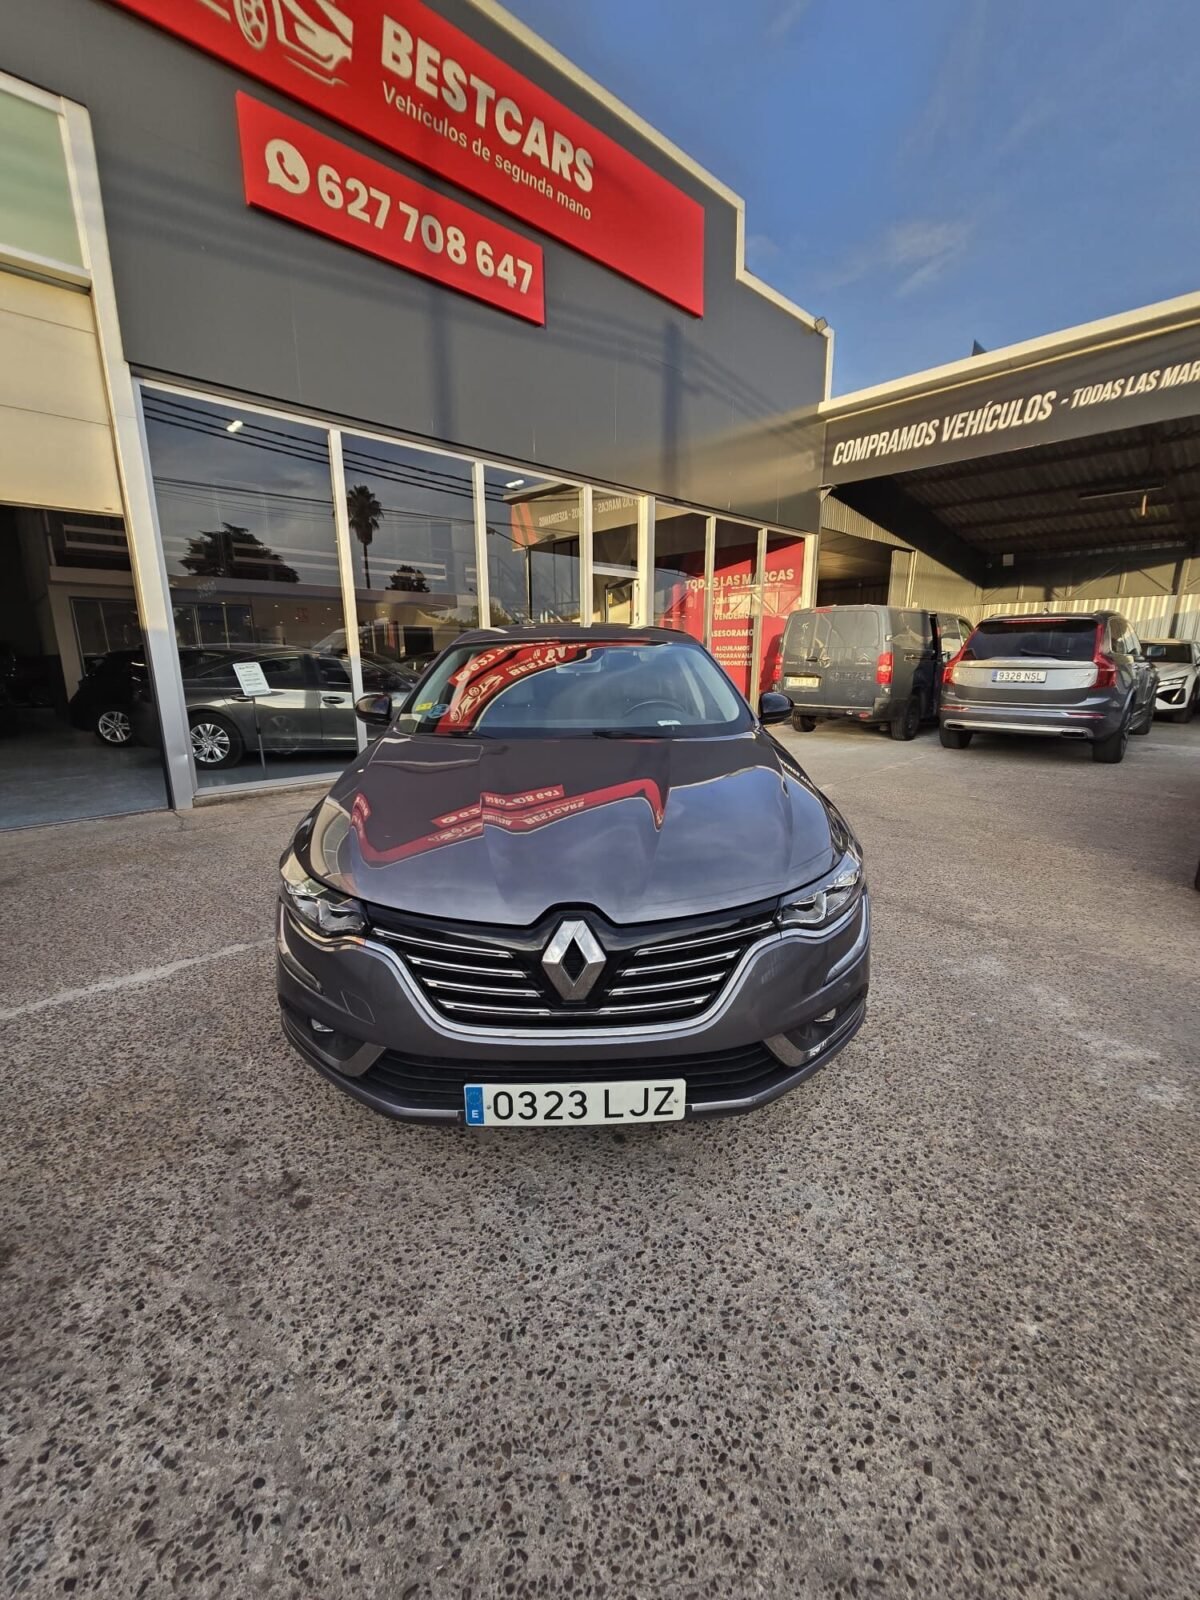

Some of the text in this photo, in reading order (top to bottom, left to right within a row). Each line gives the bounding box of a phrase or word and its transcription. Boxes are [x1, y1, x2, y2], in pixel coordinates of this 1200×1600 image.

[381, 14, 594, 193] BESTCARS
[472, 137, 491, 161] de
[495, 155, 554, 199] segunda
[556, 189, 592, 221] mano
[317, 164, 533, 294] 627 708 647
[832, 418, 940, 466] COMPRAMOS
[941, 390, 1058, 443] VEHÍCULOS
[1071, 378, 1126, 410] TODAS
[1121, 369, 1161, 398] LAS
[1158, 360, 1200, 390] MAR
[684, 568, 795, 590] TODS LAS MRCAS
[711, 629, 753, 637] SESORAMO
[999, 671, 1042, 681] 9328 NSL
[471, 1110, 479, 1119] E
[493, 1086, 675, 1120] 0323 LJZ
